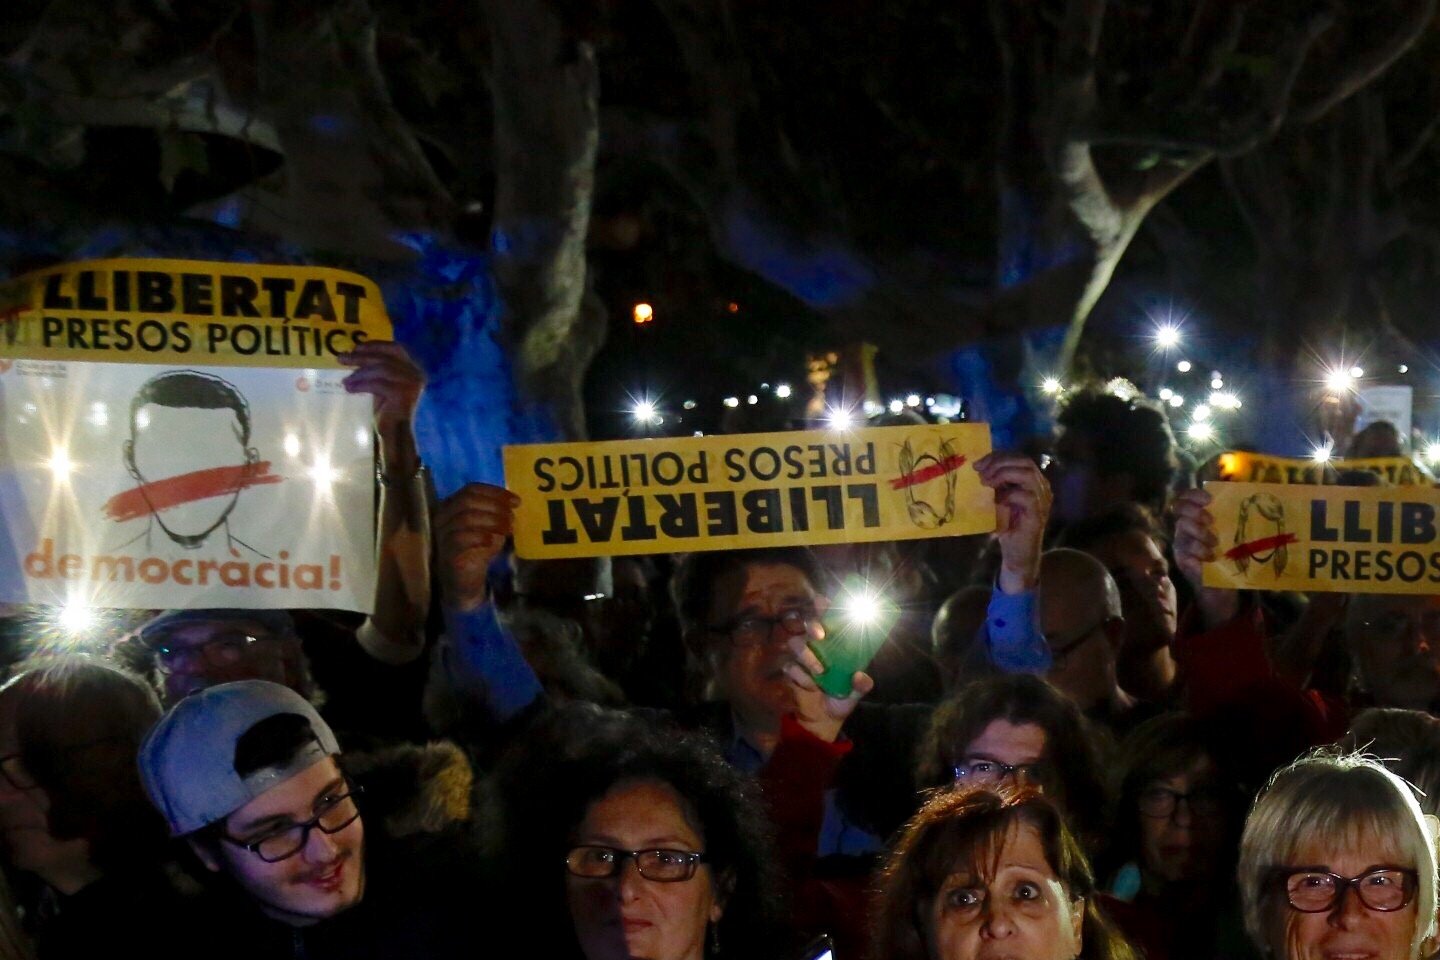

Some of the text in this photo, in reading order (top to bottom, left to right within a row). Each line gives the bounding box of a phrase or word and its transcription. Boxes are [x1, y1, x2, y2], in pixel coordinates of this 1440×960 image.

[44, 270, 367, 325] LLIBERTAT
[43, 316, 191, 353] PRESOS
[534, 441, 876, 497] PRESOS POLÍTICS
[542, 484, 880, 545] LLIBERTAT
[24, 538, 341, 592] democràcia!
